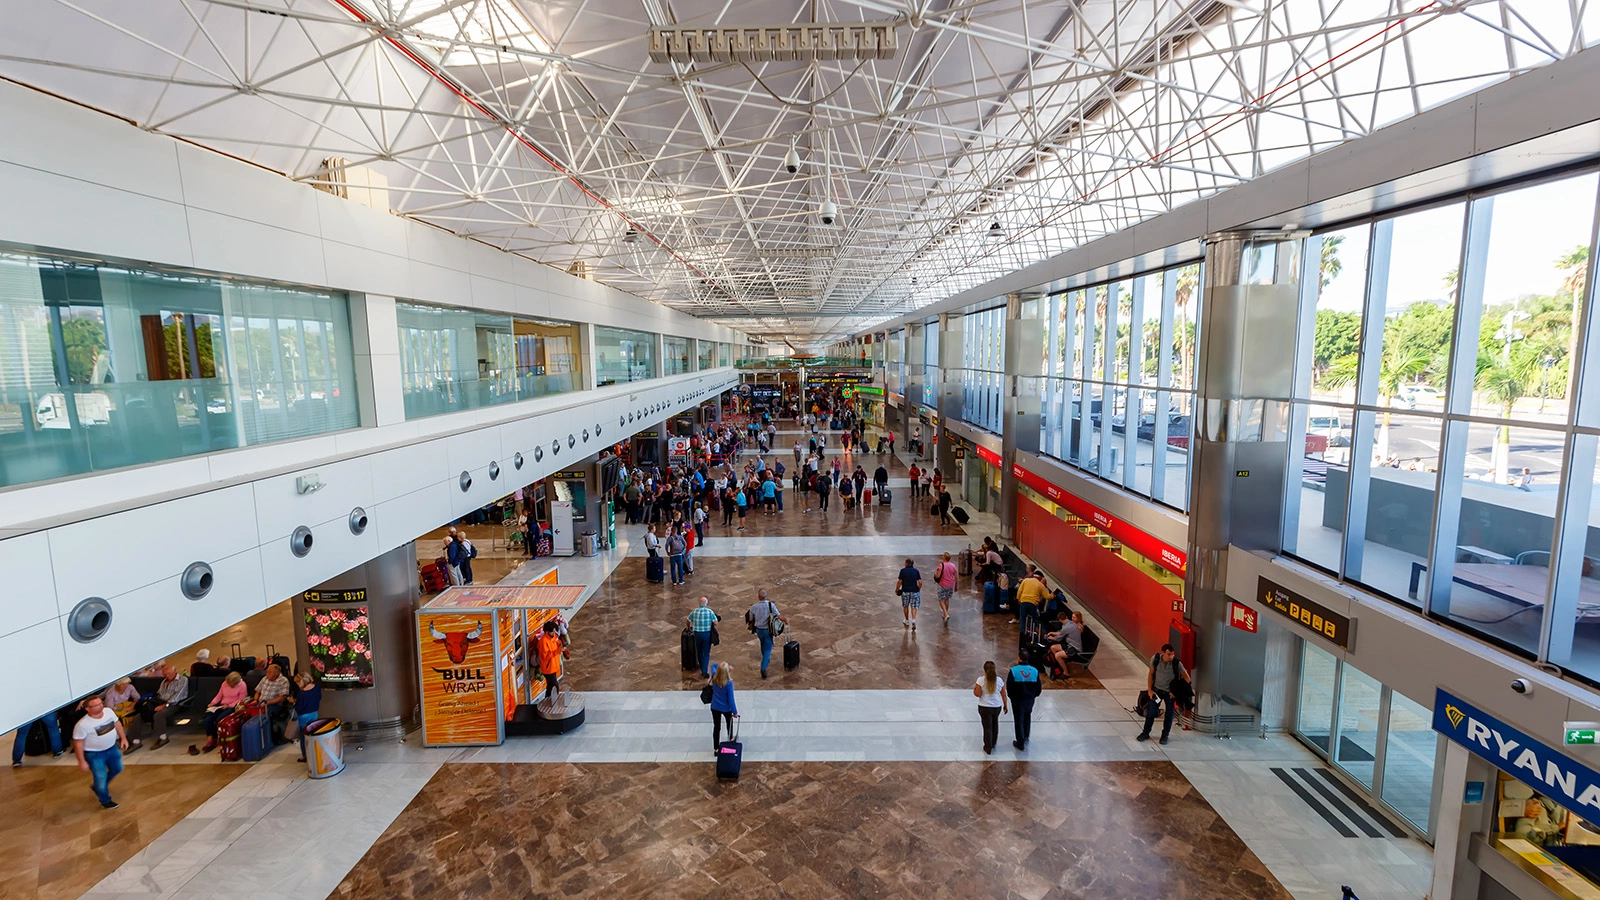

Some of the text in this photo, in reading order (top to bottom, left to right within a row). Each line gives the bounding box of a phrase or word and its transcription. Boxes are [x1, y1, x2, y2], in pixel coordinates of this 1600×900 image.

[1161, 548, 1182, 565] IBERIA
[343, 592, 351, 601] 13
[356, 591, 365, 600] 17
[436, 668, 486, 680] BULL
[442, 682, 486, 693] WRAP
[1466, 716, 1600, 811] RYANA
